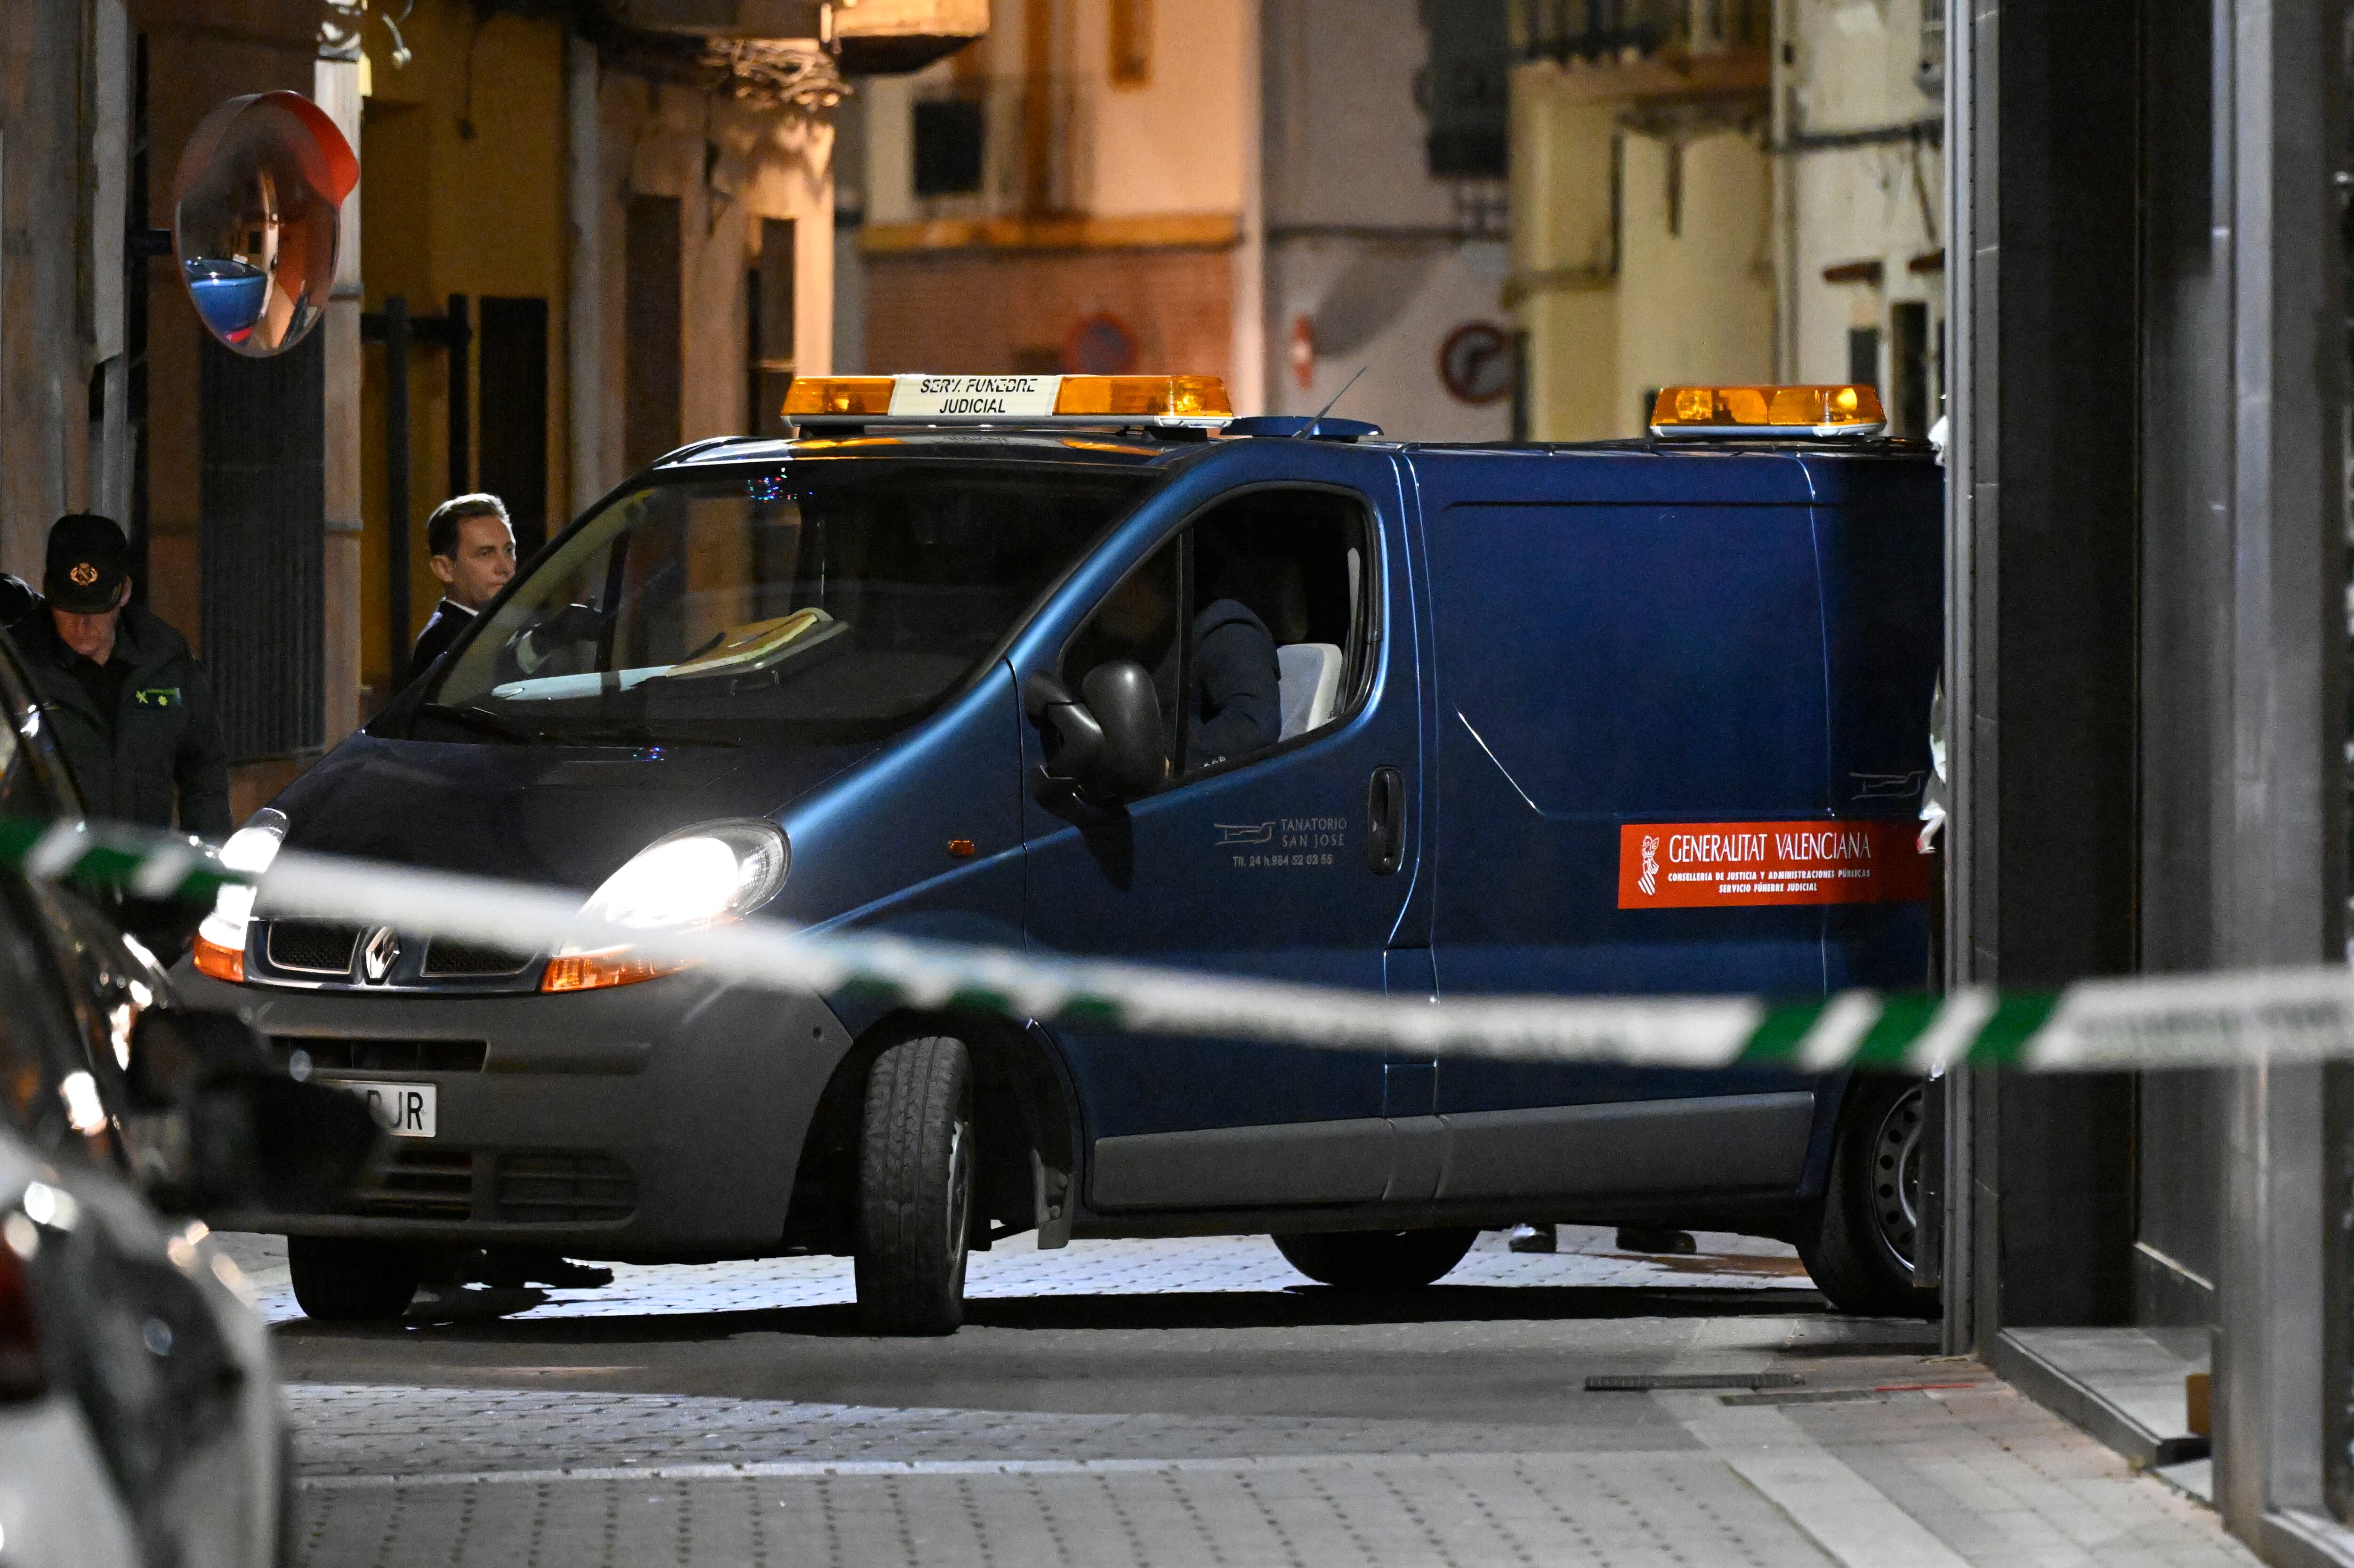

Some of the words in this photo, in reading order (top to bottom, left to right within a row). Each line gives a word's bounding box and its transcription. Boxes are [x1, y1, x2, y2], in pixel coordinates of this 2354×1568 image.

[939, 398, 1006, 414] JUDICIAL
[1281, 817, 1347, 831] TANATORIO
[1282, 834, 1307, 847] SAN
[1314, 834, 1345, 848] JOSE
[1669, 833, 1768, 862] GENERALITAT
[1774, 832, 1871, 861] VALENCIANA
[1668, 872, 1713, 882] CONSELLERIA
[1715, 872, 1725, 881] DE
[1727, 871, 1757, 881] JUSTICIA
[1760, 871, 1765, 880] Y
[1768, 870, 1835, 880] ADMINISTRACIONES
[1838, 868, 1870, 878] PÚBLICAS
[1719, 884, 1751, 893] SERVICIO
[1754, 882, 1784, 893] FÚNEBRE
[1787, 883, 1818, 892] JUDICIAL
